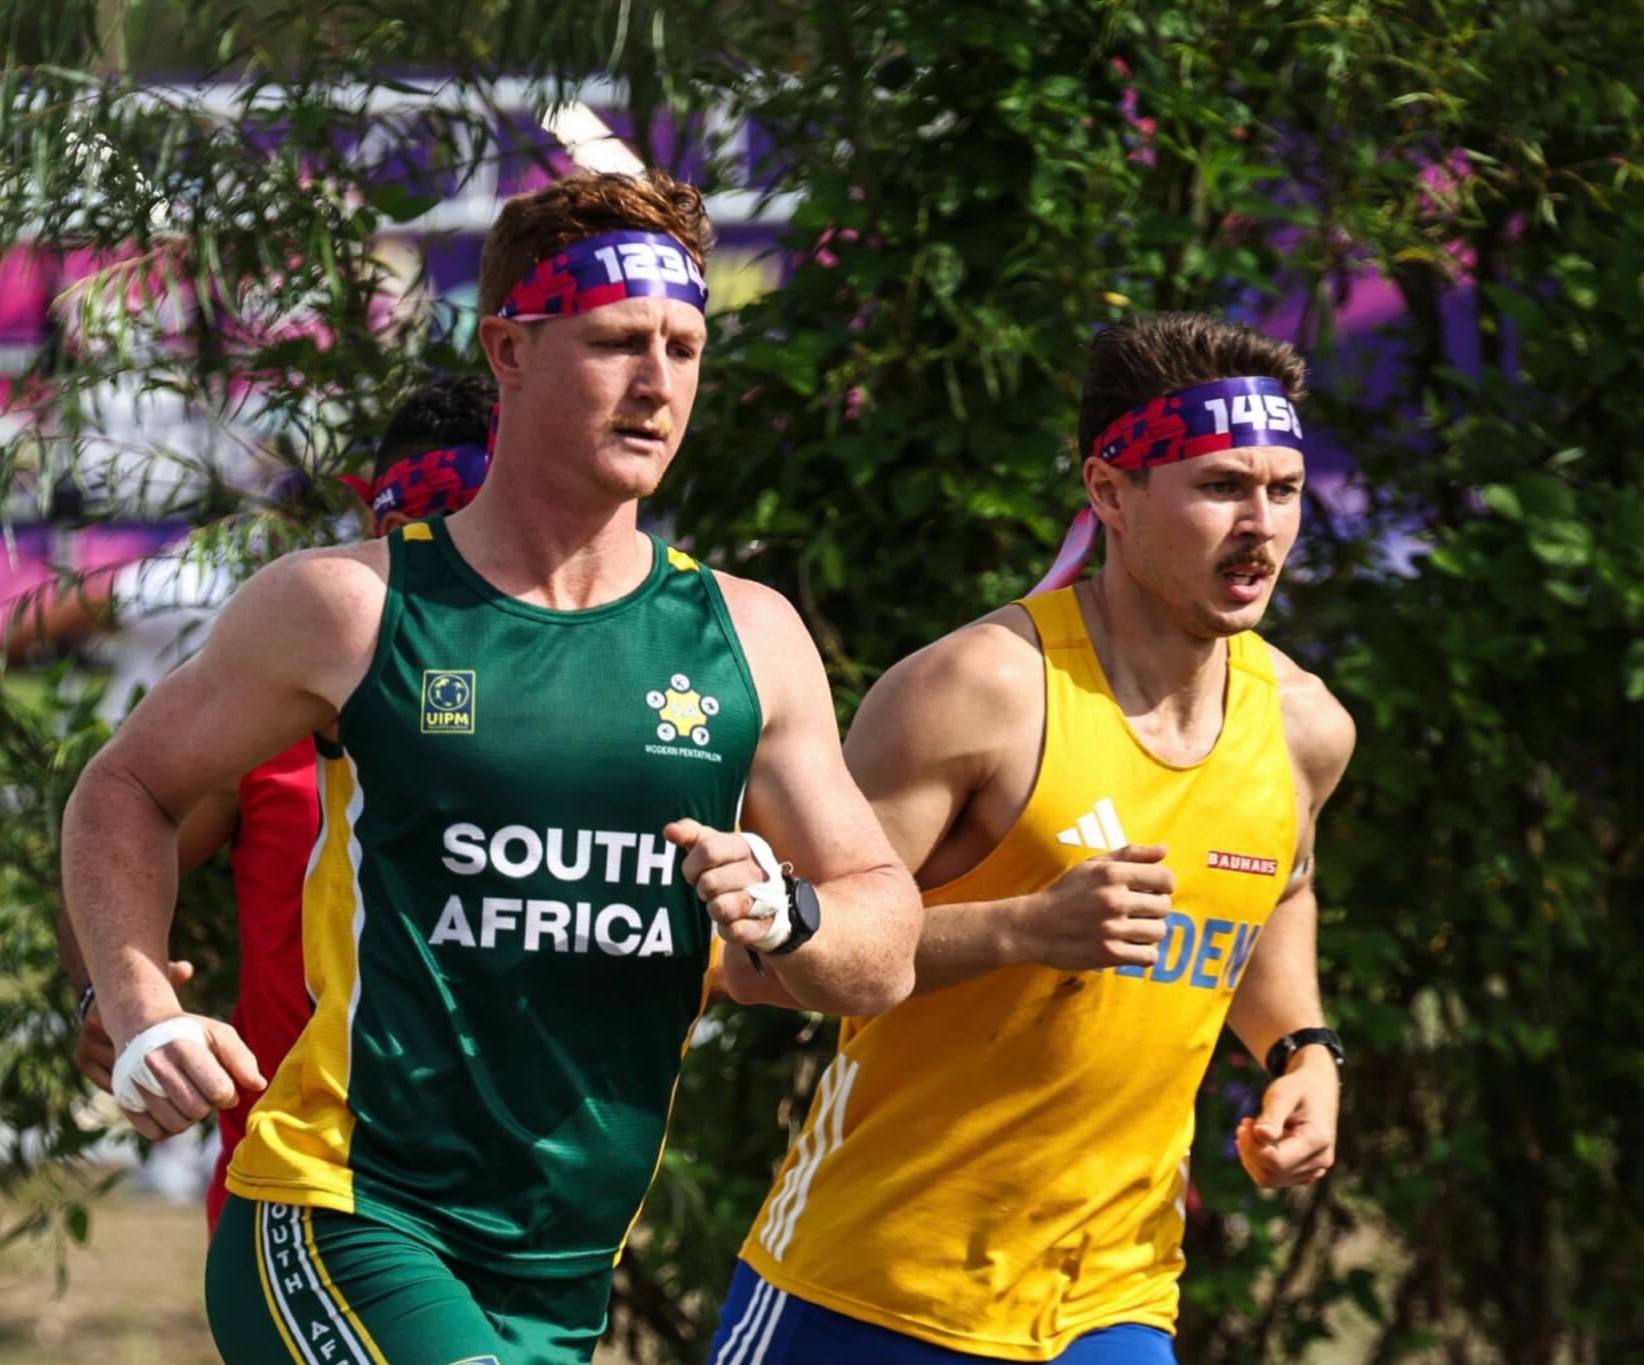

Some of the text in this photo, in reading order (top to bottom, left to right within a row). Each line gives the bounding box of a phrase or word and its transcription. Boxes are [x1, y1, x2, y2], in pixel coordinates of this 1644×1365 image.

[594, 243, 706, 297] 1234
[425, 711, 470, 726] UIPM
[441, 822, 678, 887] SOUTH
[1207, 851, 1276, 874] BAUHAUS
[428, 894, 674, 959] AFRICA
[269, 1202, 304, 1296] OUTH
